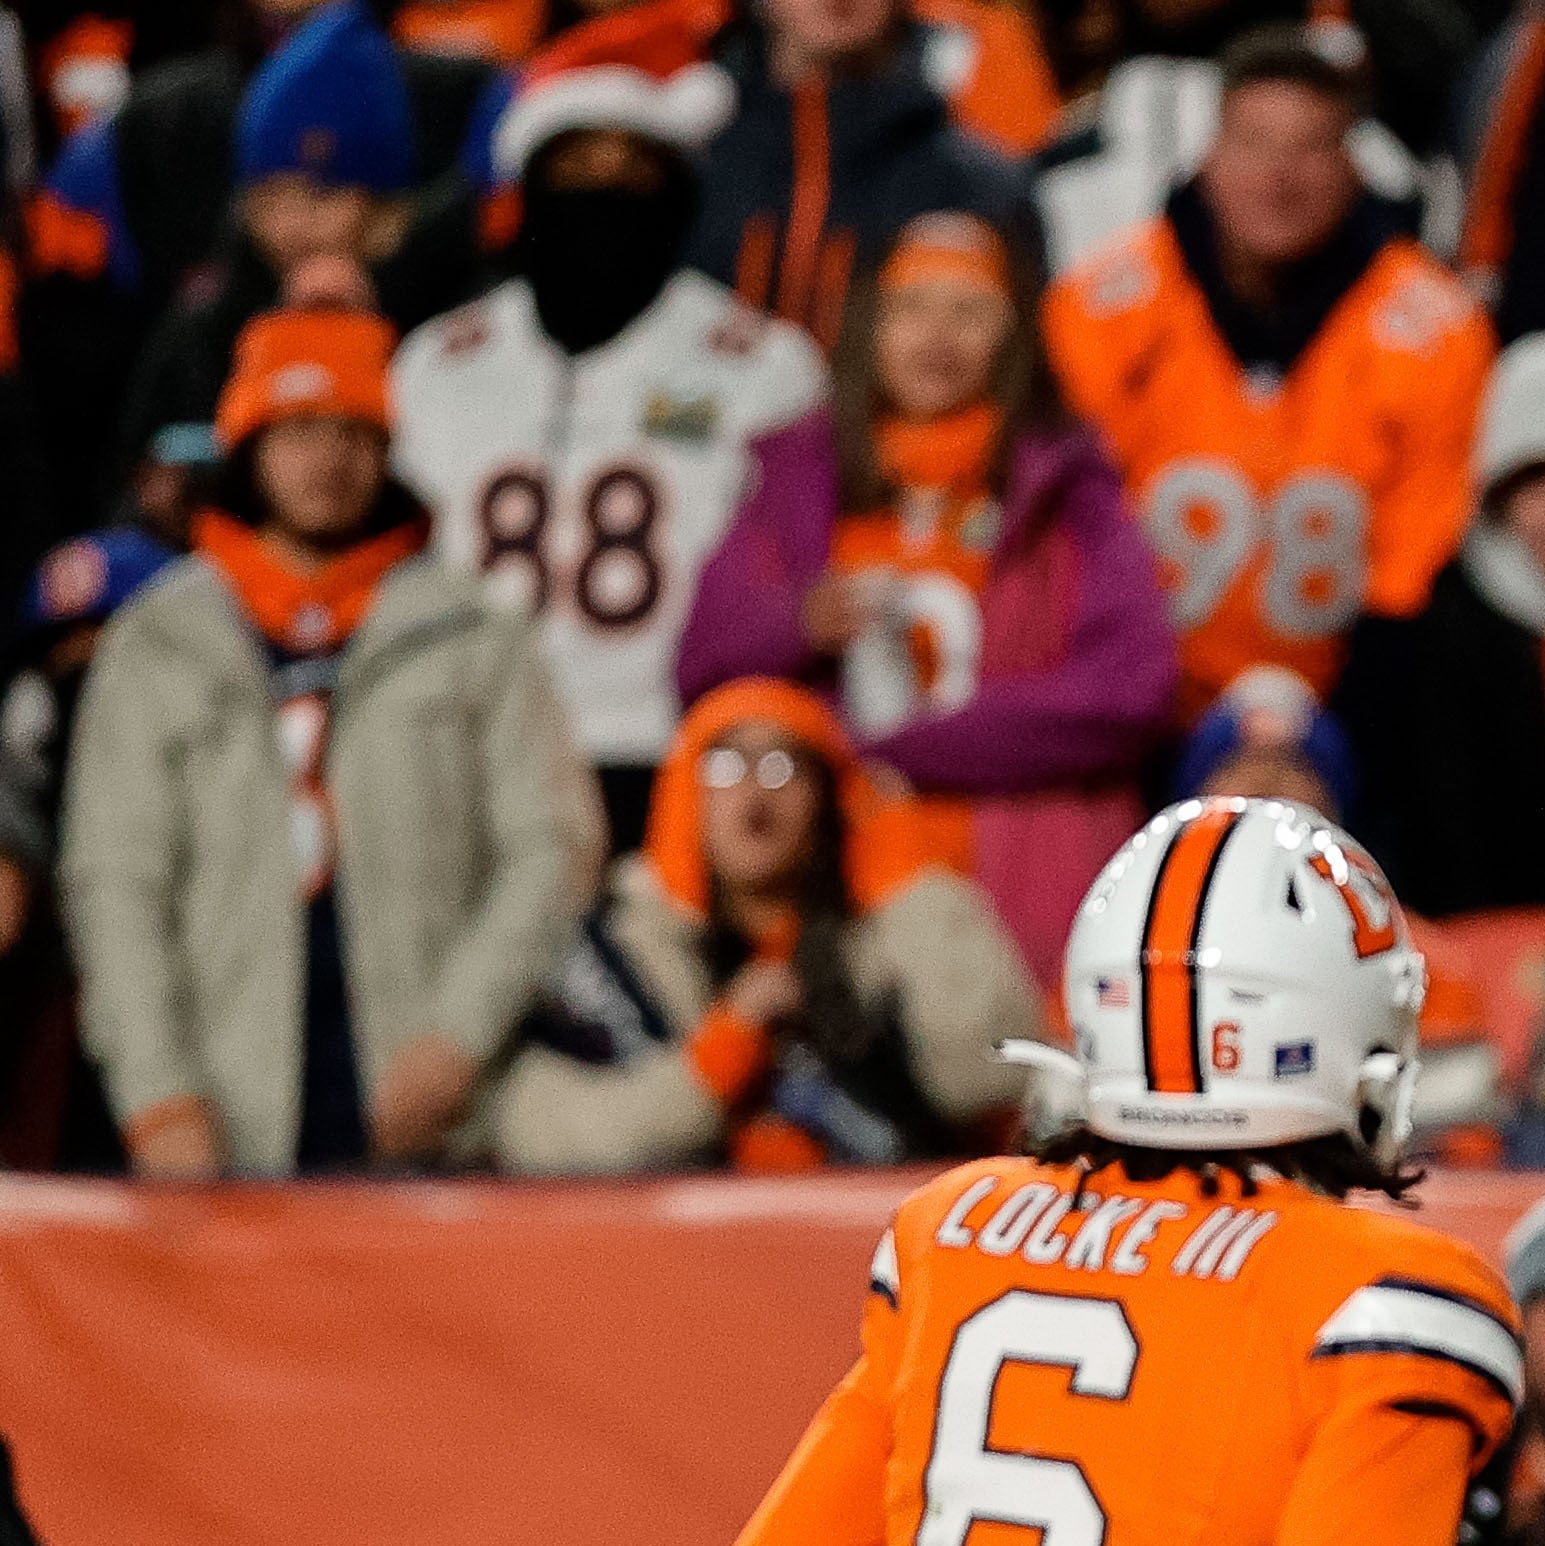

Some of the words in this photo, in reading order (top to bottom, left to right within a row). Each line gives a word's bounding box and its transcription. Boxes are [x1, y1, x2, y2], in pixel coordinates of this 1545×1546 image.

[472, 464, 666, 632] 88
[1143, 455, 1374, 640] 98
[1212, 1022, 1242, 1072] 6
[936, 1176, 1187, 1276] LOCKE
[1171, 1205, 1279, 1281] III
